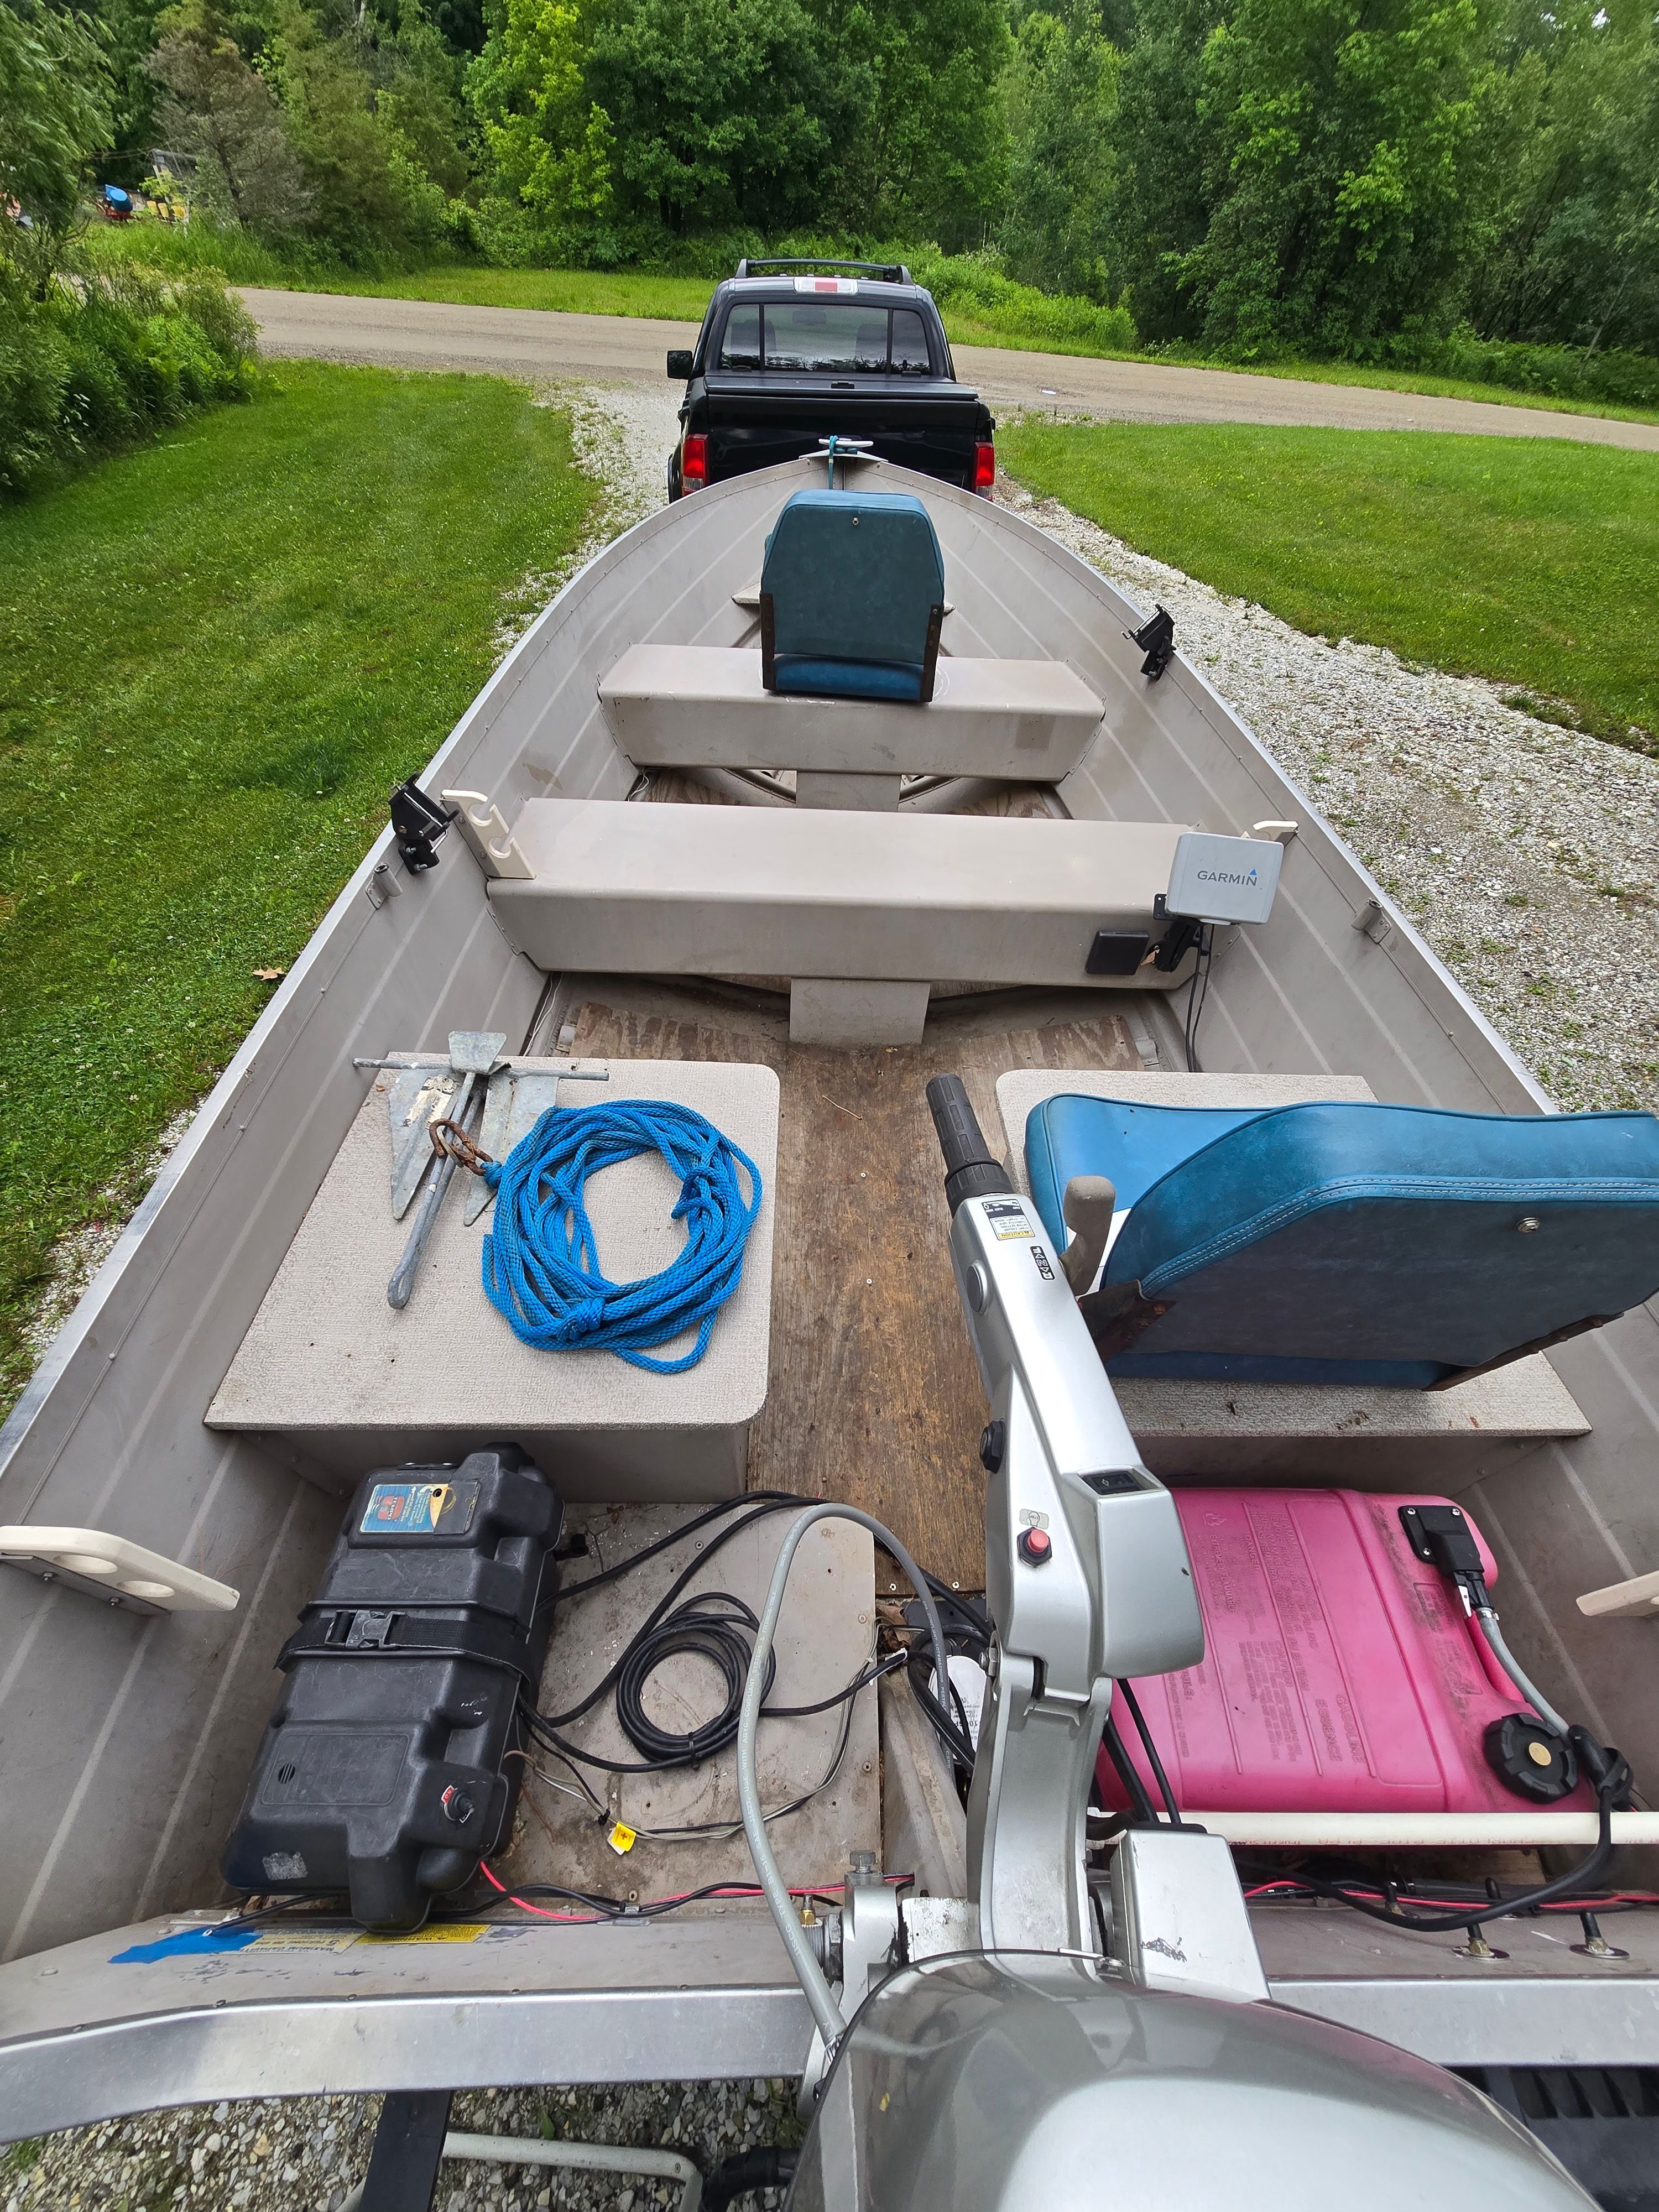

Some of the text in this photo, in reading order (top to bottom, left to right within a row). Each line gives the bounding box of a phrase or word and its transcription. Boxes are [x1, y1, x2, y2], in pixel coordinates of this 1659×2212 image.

[1197, 870, 1258, 886] GARMIN
[1245, 1535, 1261, 1571] DANGER
[1280, 1545, 1292, 1567] FROM
[1209, 1535, 1237, 1613] EXTREMELY FLAMMABLE
[927, 1613, 938, 1641] COMPLIANT
[752, 1645, 763, 1674] SYSTEMS
[1274, 1640, 1293, 1687] CAUTION
[1292, 1653, 1311, 1691] BATEAU
[744, 1678, 756, 1717] COMPLIANT
[1315, 1699, 1343, 1762] ESSENCE
[1336, 1694, 1365, 1764] GASOLINE
[753, 1829, 762, 1849] SAE
[773, 1891, 785, 1919] TYPE
[786, 1924, 800, 1956] USCG
